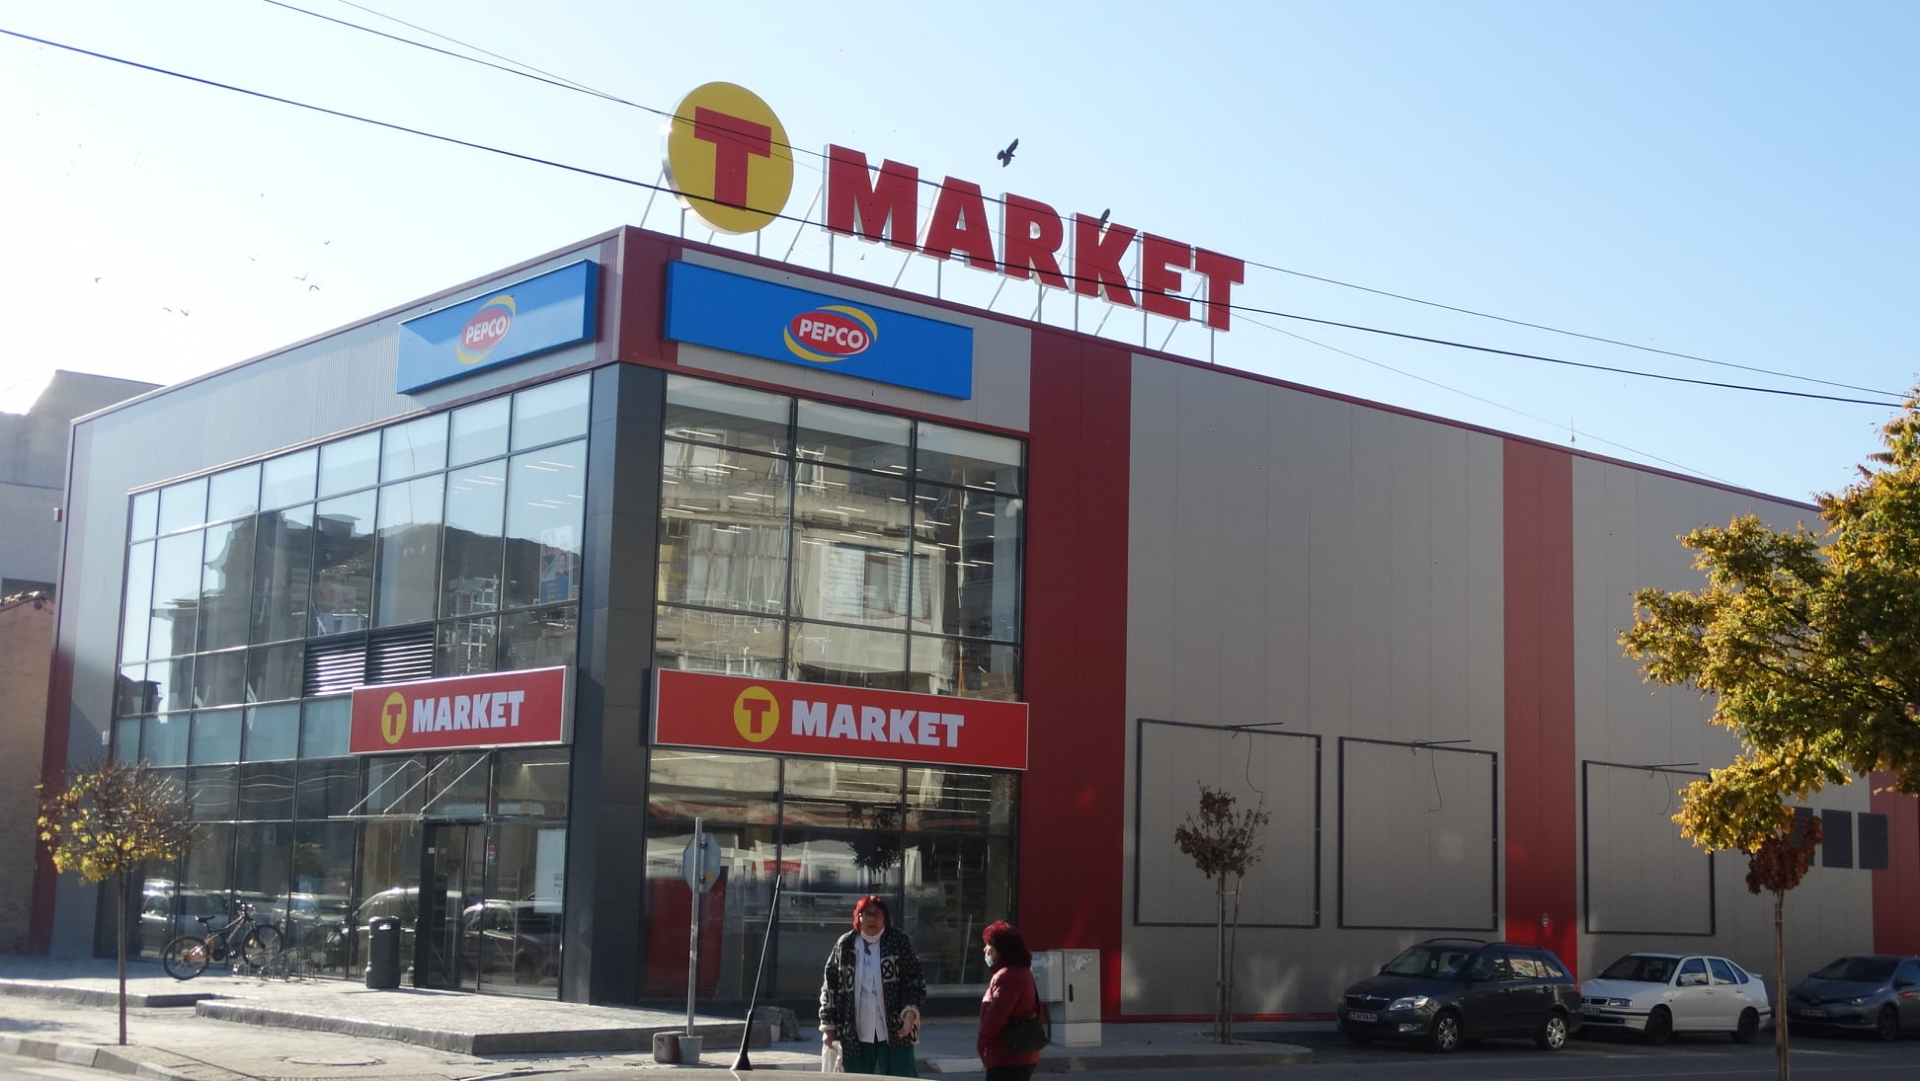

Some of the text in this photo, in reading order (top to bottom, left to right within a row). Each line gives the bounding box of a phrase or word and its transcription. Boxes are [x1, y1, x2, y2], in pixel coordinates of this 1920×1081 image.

[694, 106, 1245, 333] T MARKET
[465, 315, 507, 345] PEPCO
[799, 318, 864, 349] PEPCO
[387, 690, 525, 736] T MARKET
[743, 698, 965, 748] T MARKET
